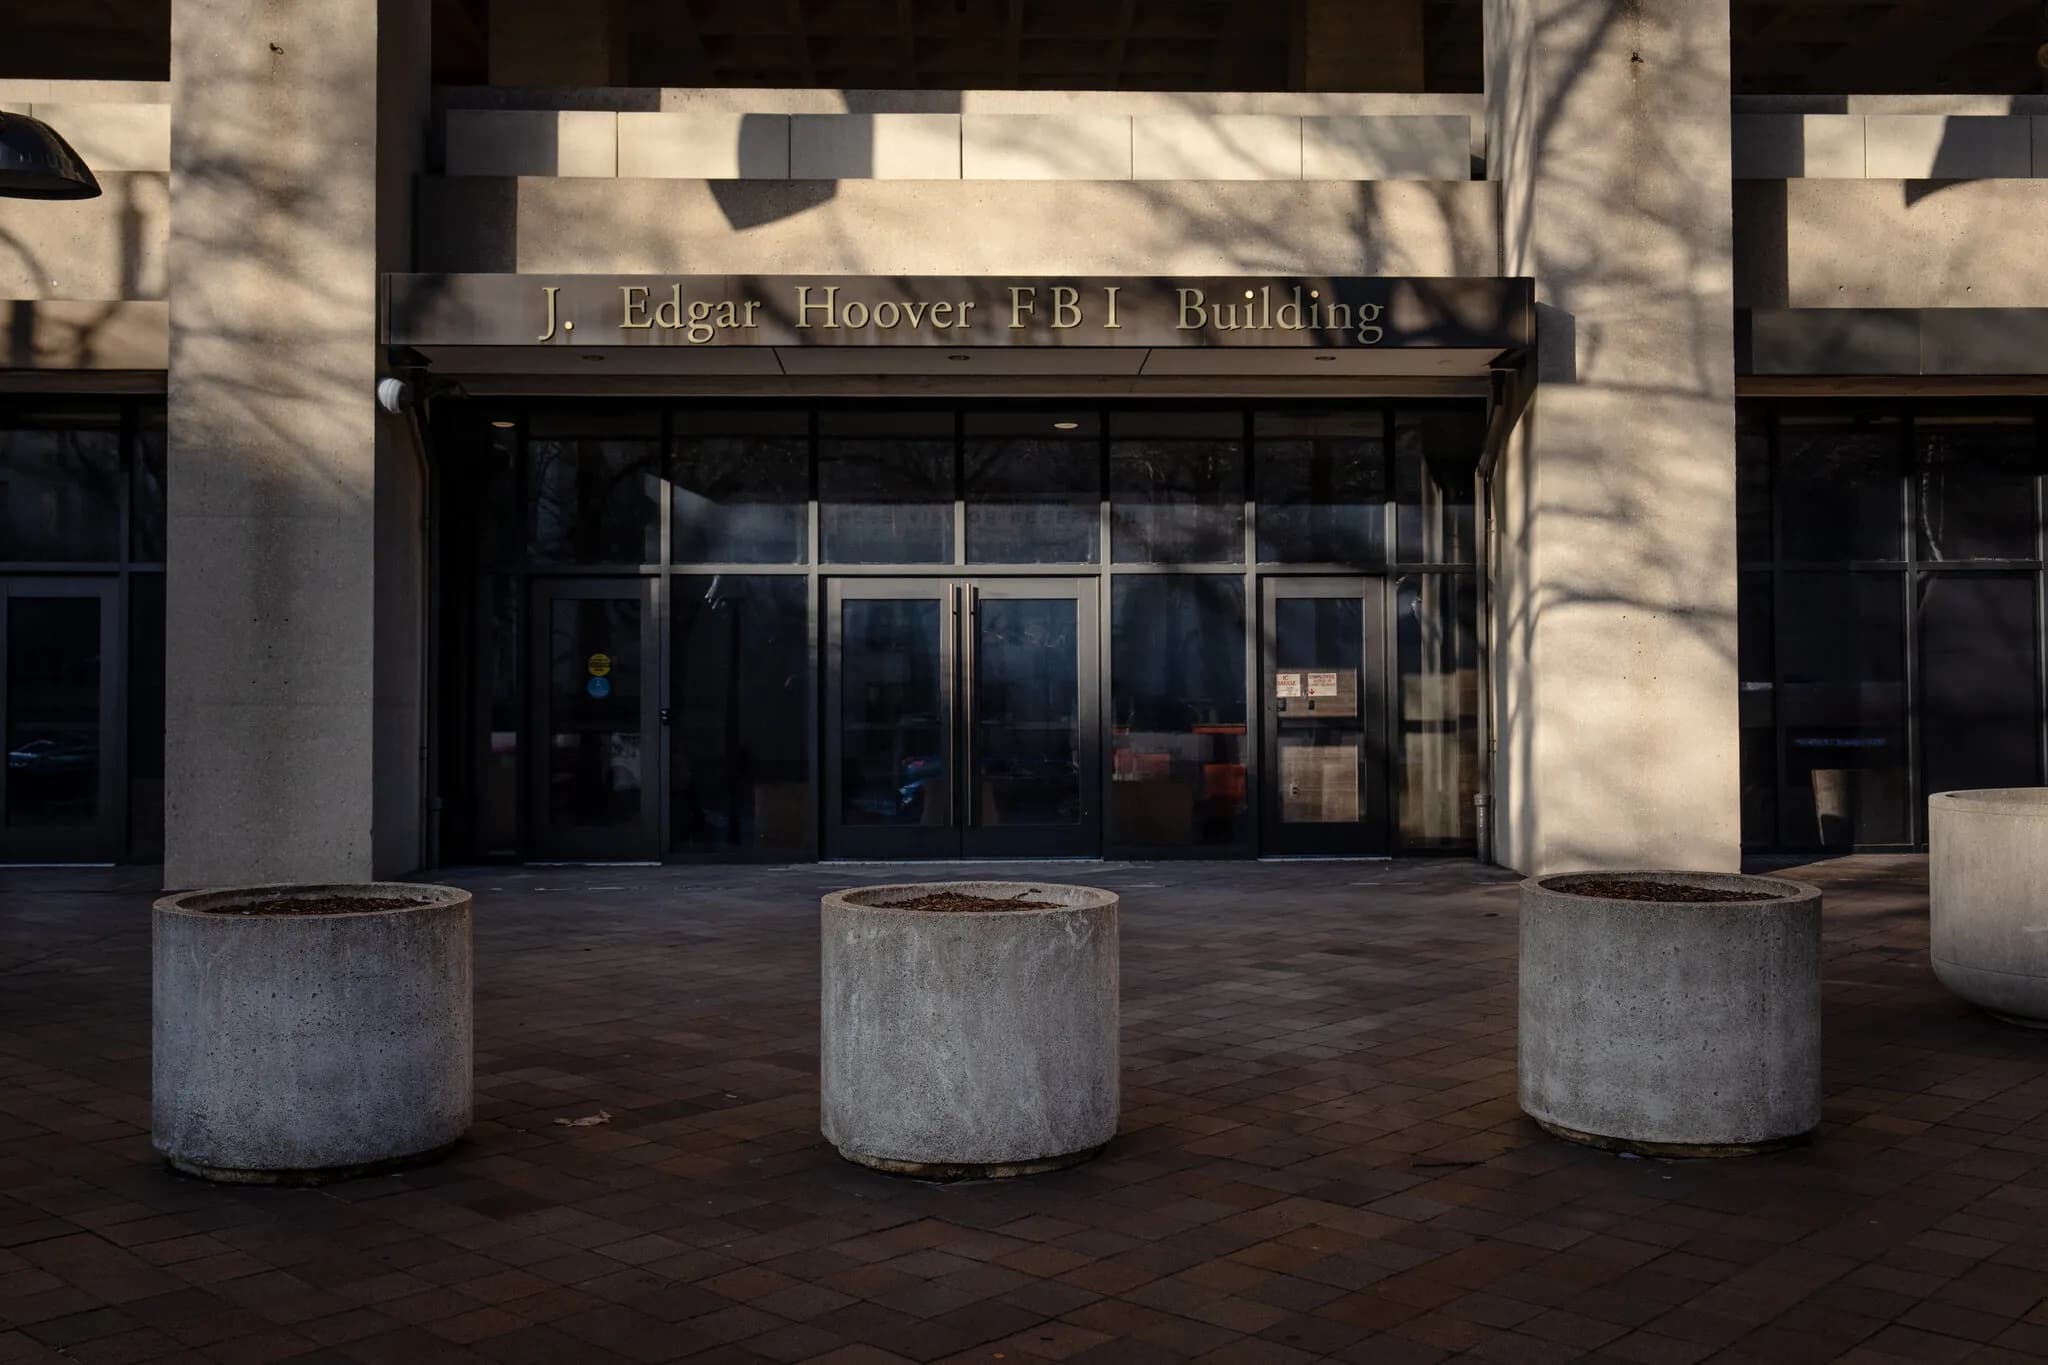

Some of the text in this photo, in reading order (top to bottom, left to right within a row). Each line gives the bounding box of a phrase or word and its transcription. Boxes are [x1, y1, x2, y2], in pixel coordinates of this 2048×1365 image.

[537, 287, 575, 341] J.
[618, 283, 761, 342] Edgar
[794, 286, 976, 328] Hoover
[1175, 285, 1384, 344] Building
